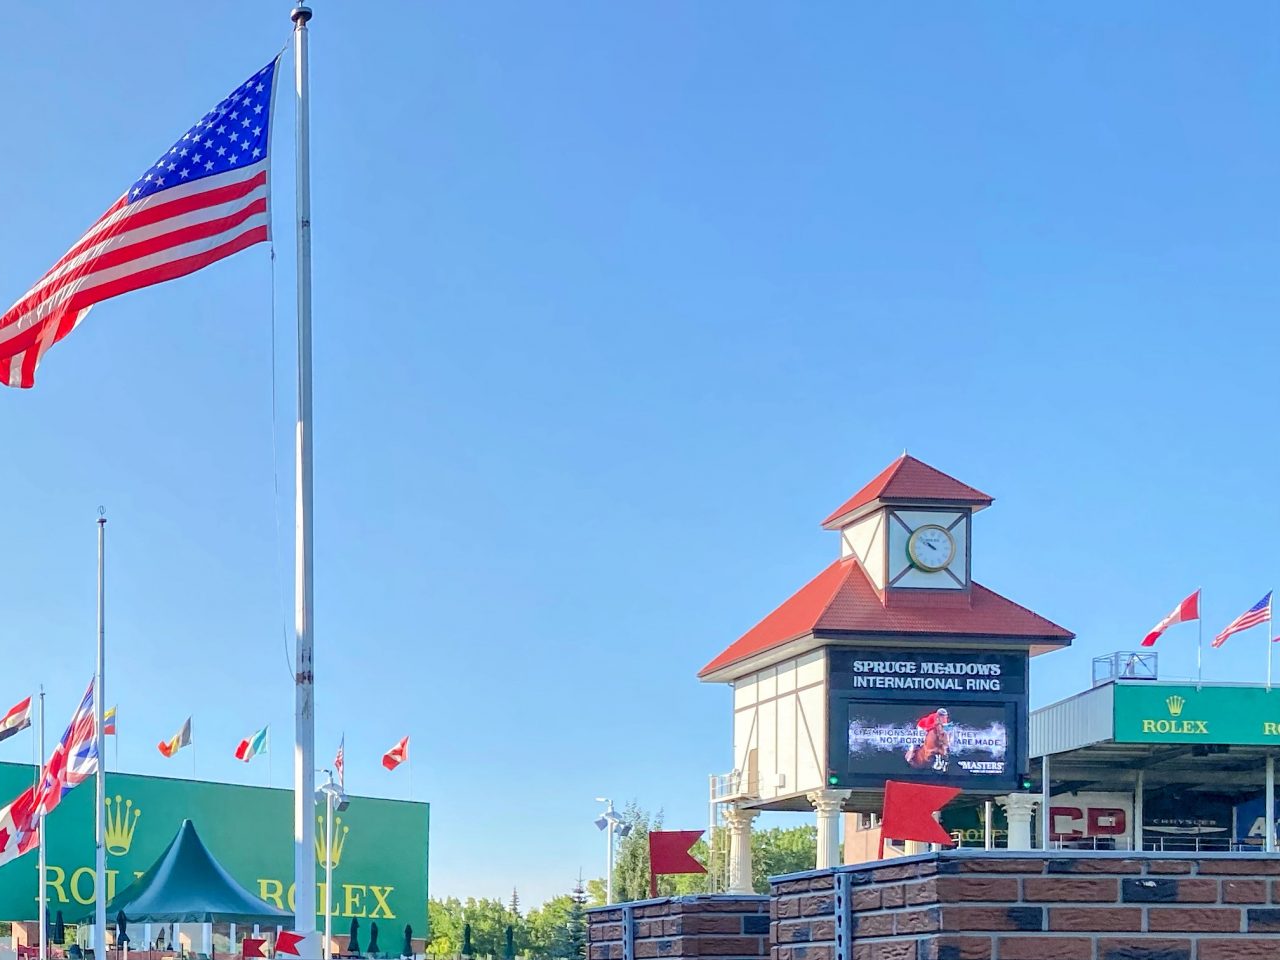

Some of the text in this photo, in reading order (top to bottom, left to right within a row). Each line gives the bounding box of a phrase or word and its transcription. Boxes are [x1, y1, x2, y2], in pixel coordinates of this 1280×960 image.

[853, 660, 1001, 675] SPRUCE MEADOWS
[853, 676, 1001, 691] INTERNATIONAL RING
[1142, 719, 1209, 734] ROLEX
[879, 736, 925, 744] NOT BORN
[956, 738, 973, 746] ARE
